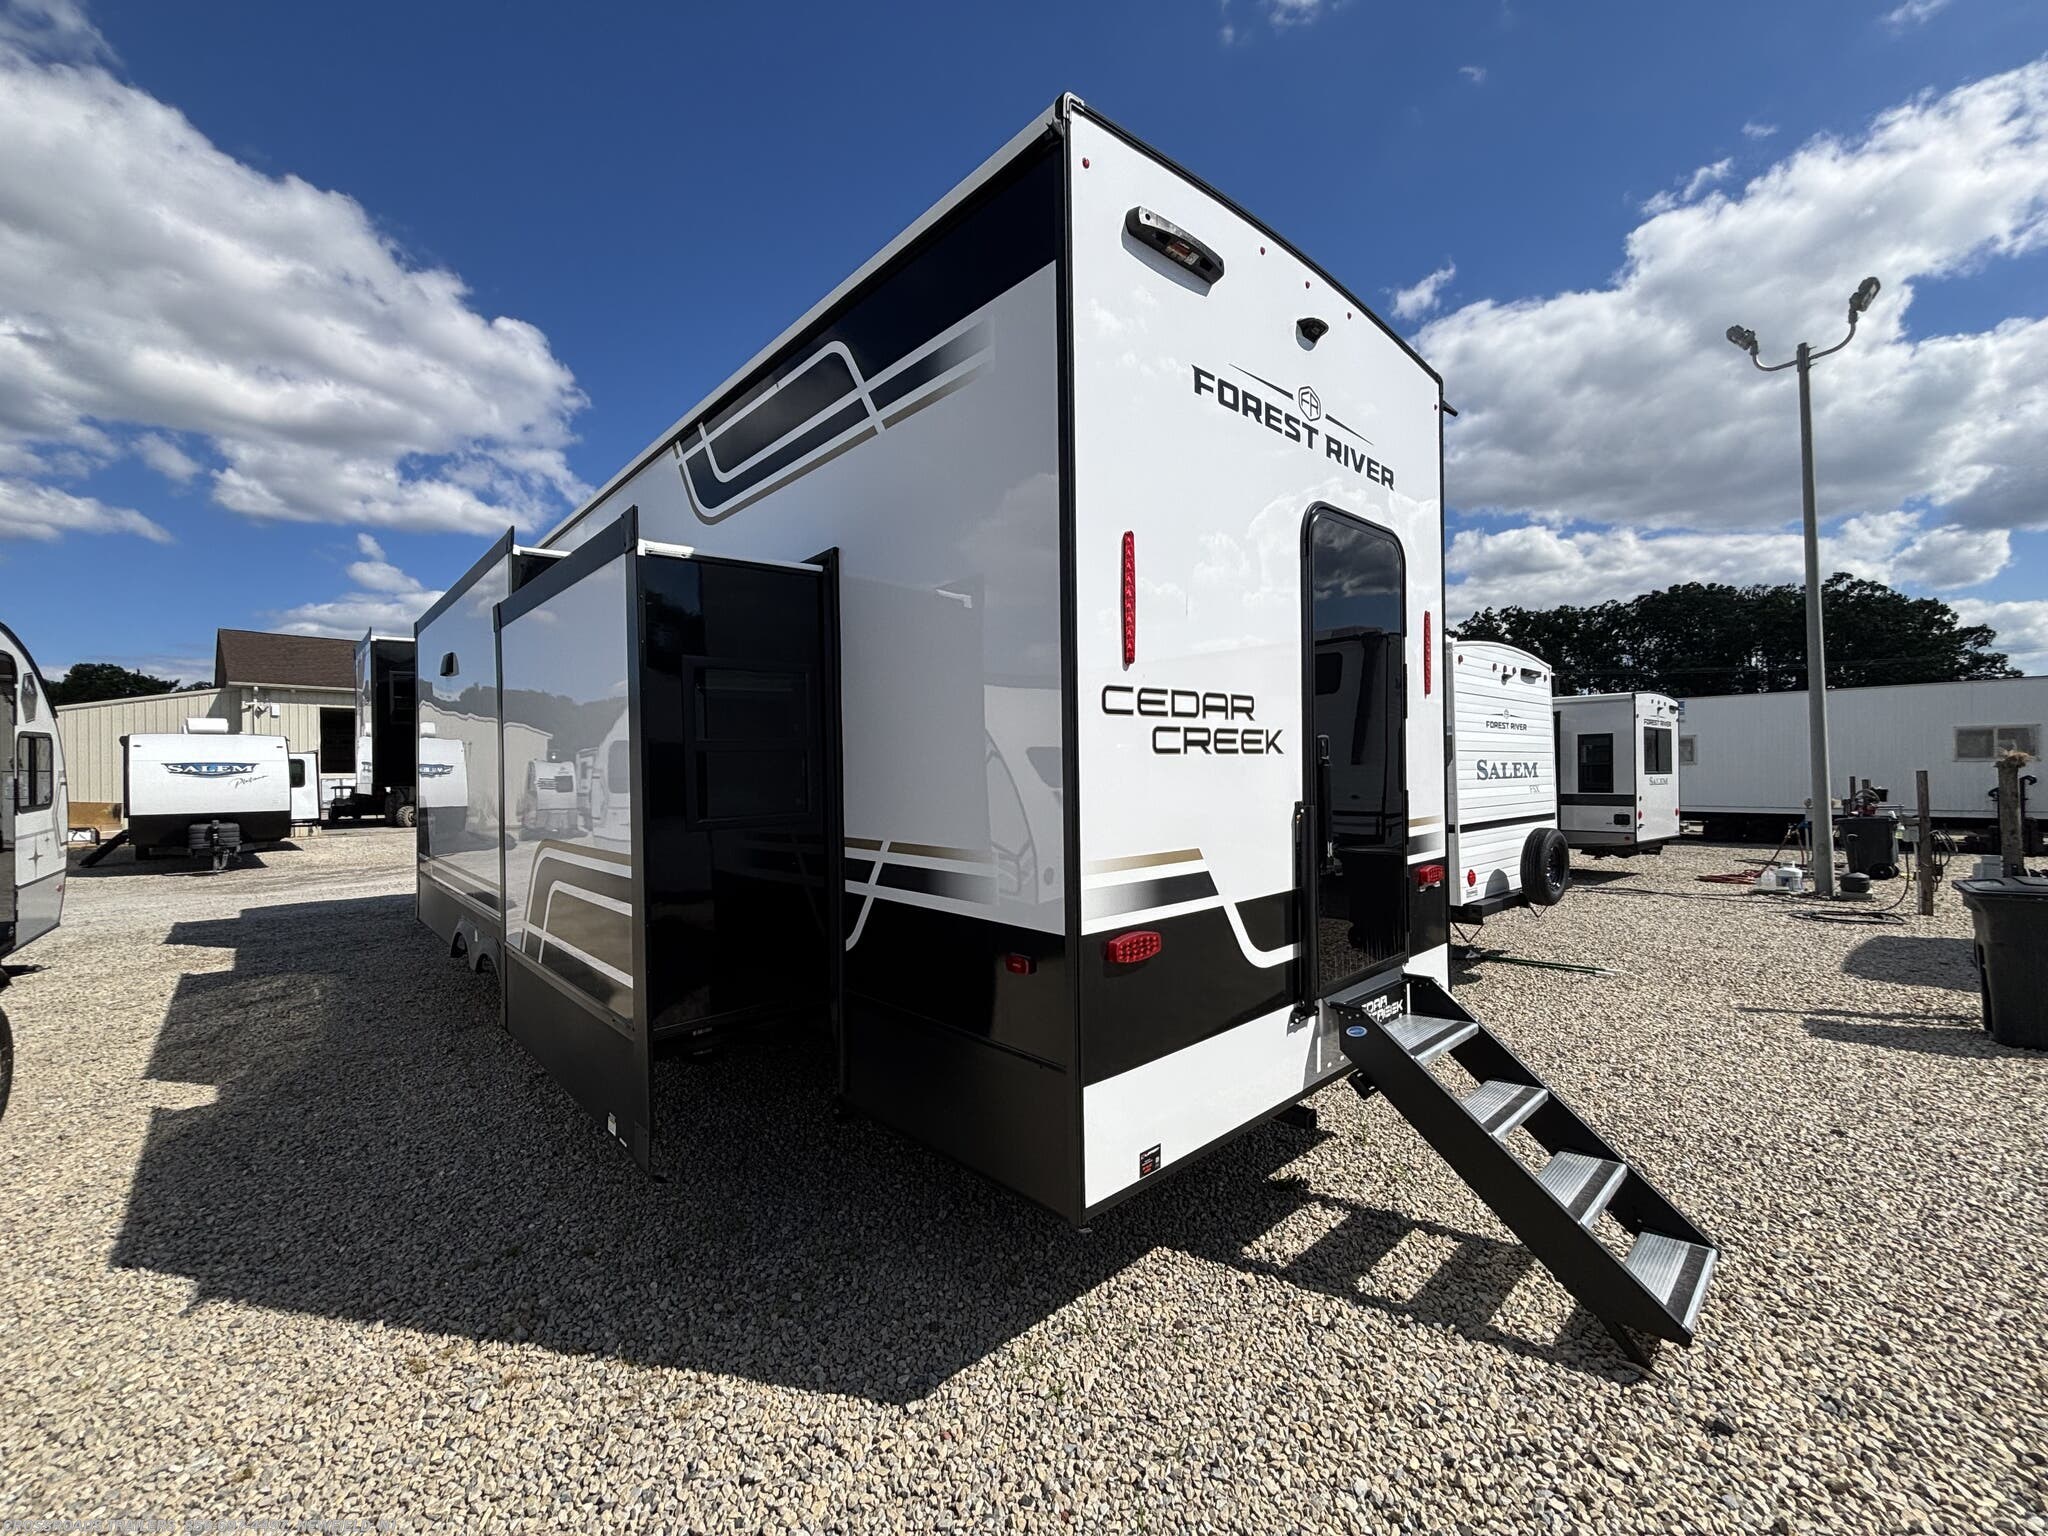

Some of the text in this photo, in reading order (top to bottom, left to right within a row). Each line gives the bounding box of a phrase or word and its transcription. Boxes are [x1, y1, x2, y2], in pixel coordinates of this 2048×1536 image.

[1191, 364, 1395, 491] FOREST RIVER
[1101, 684, 1256, 722] CEDAR
[1485, 720, 1528, 731] FOREST RIVER
[1152, 726, 1285, 755] CREEK
[167, 764, 254, 773] SALEM
[1476, 759, 1539, 780] SALEM
